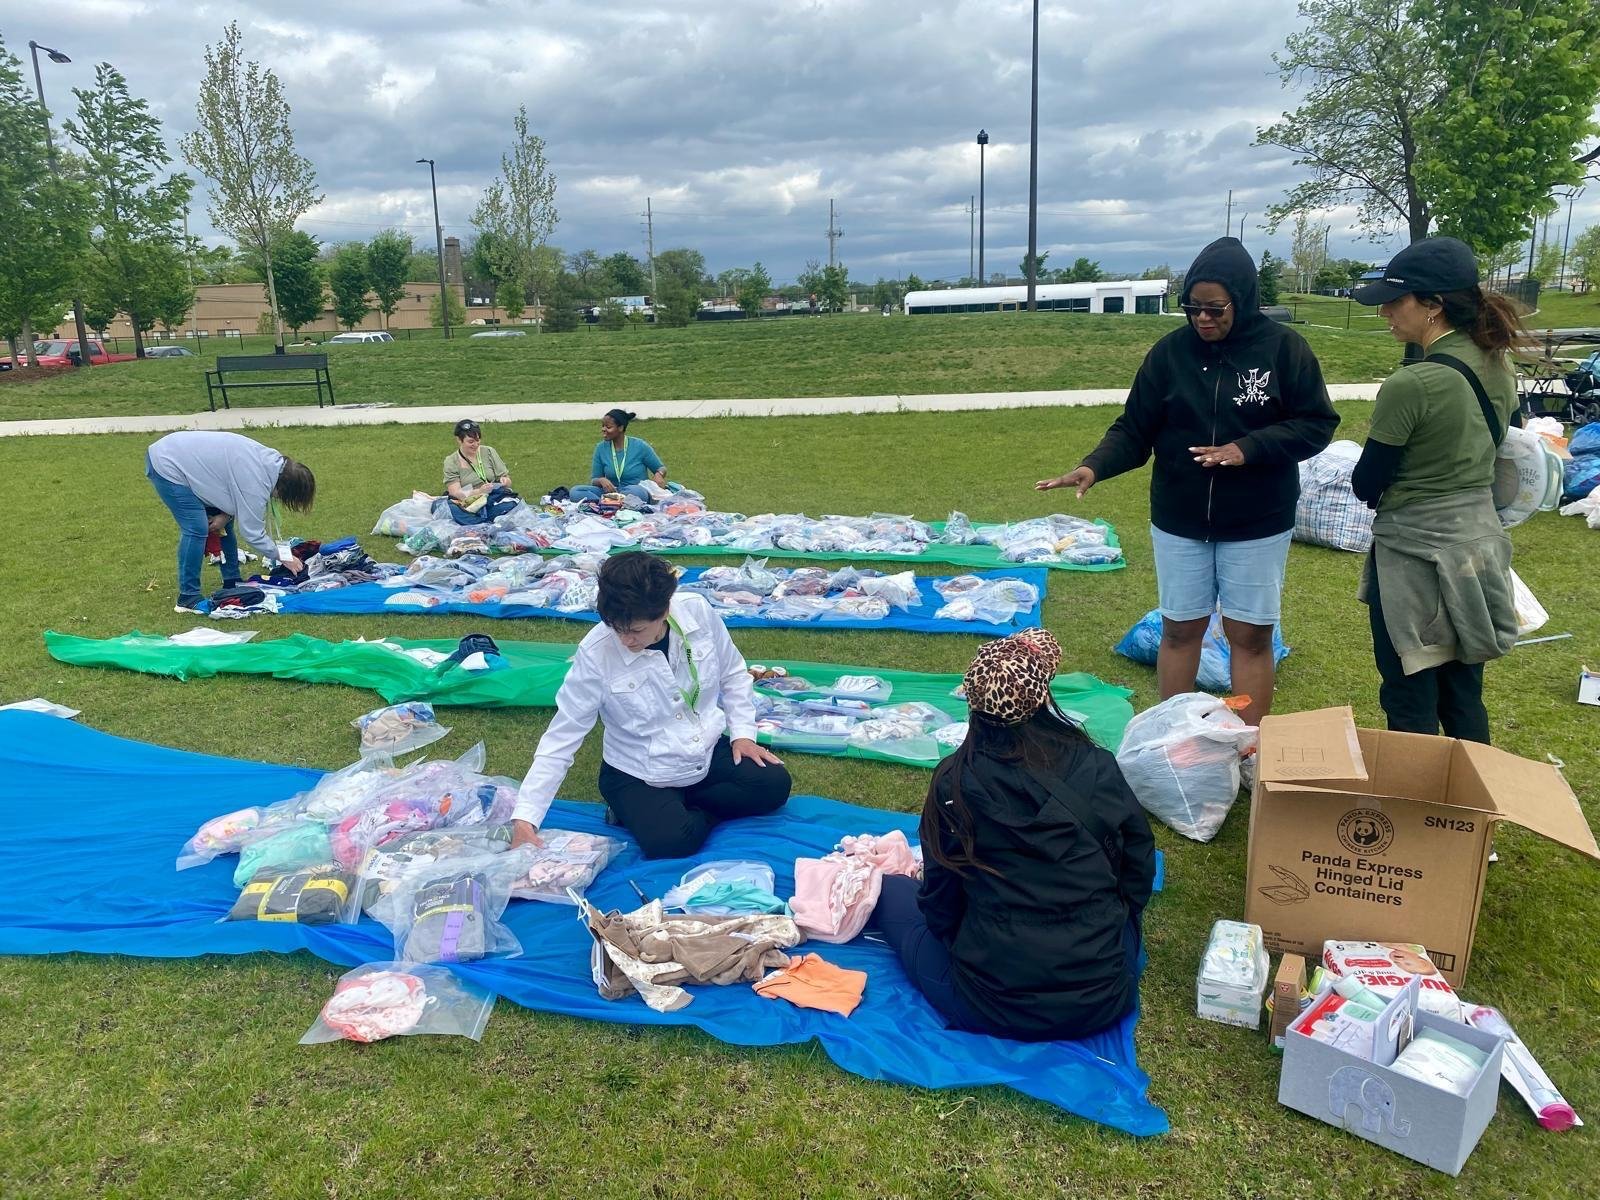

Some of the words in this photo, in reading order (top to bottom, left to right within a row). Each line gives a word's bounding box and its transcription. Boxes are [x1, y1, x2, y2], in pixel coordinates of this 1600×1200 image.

[1340, 810, 1363, 827] PANDA
[1365, 810, 1391, 833] EXPRESS
[1424, 816, 1475, 833] SN123
[1301, 850, 1351, 868] Panda
[1356, 858, 1423, 879] Express
[1316, 867, 1373, 886] Hinged
[1378, 876, 1404, 891] Lid
[1314, 881, 1402, 906] Containers
